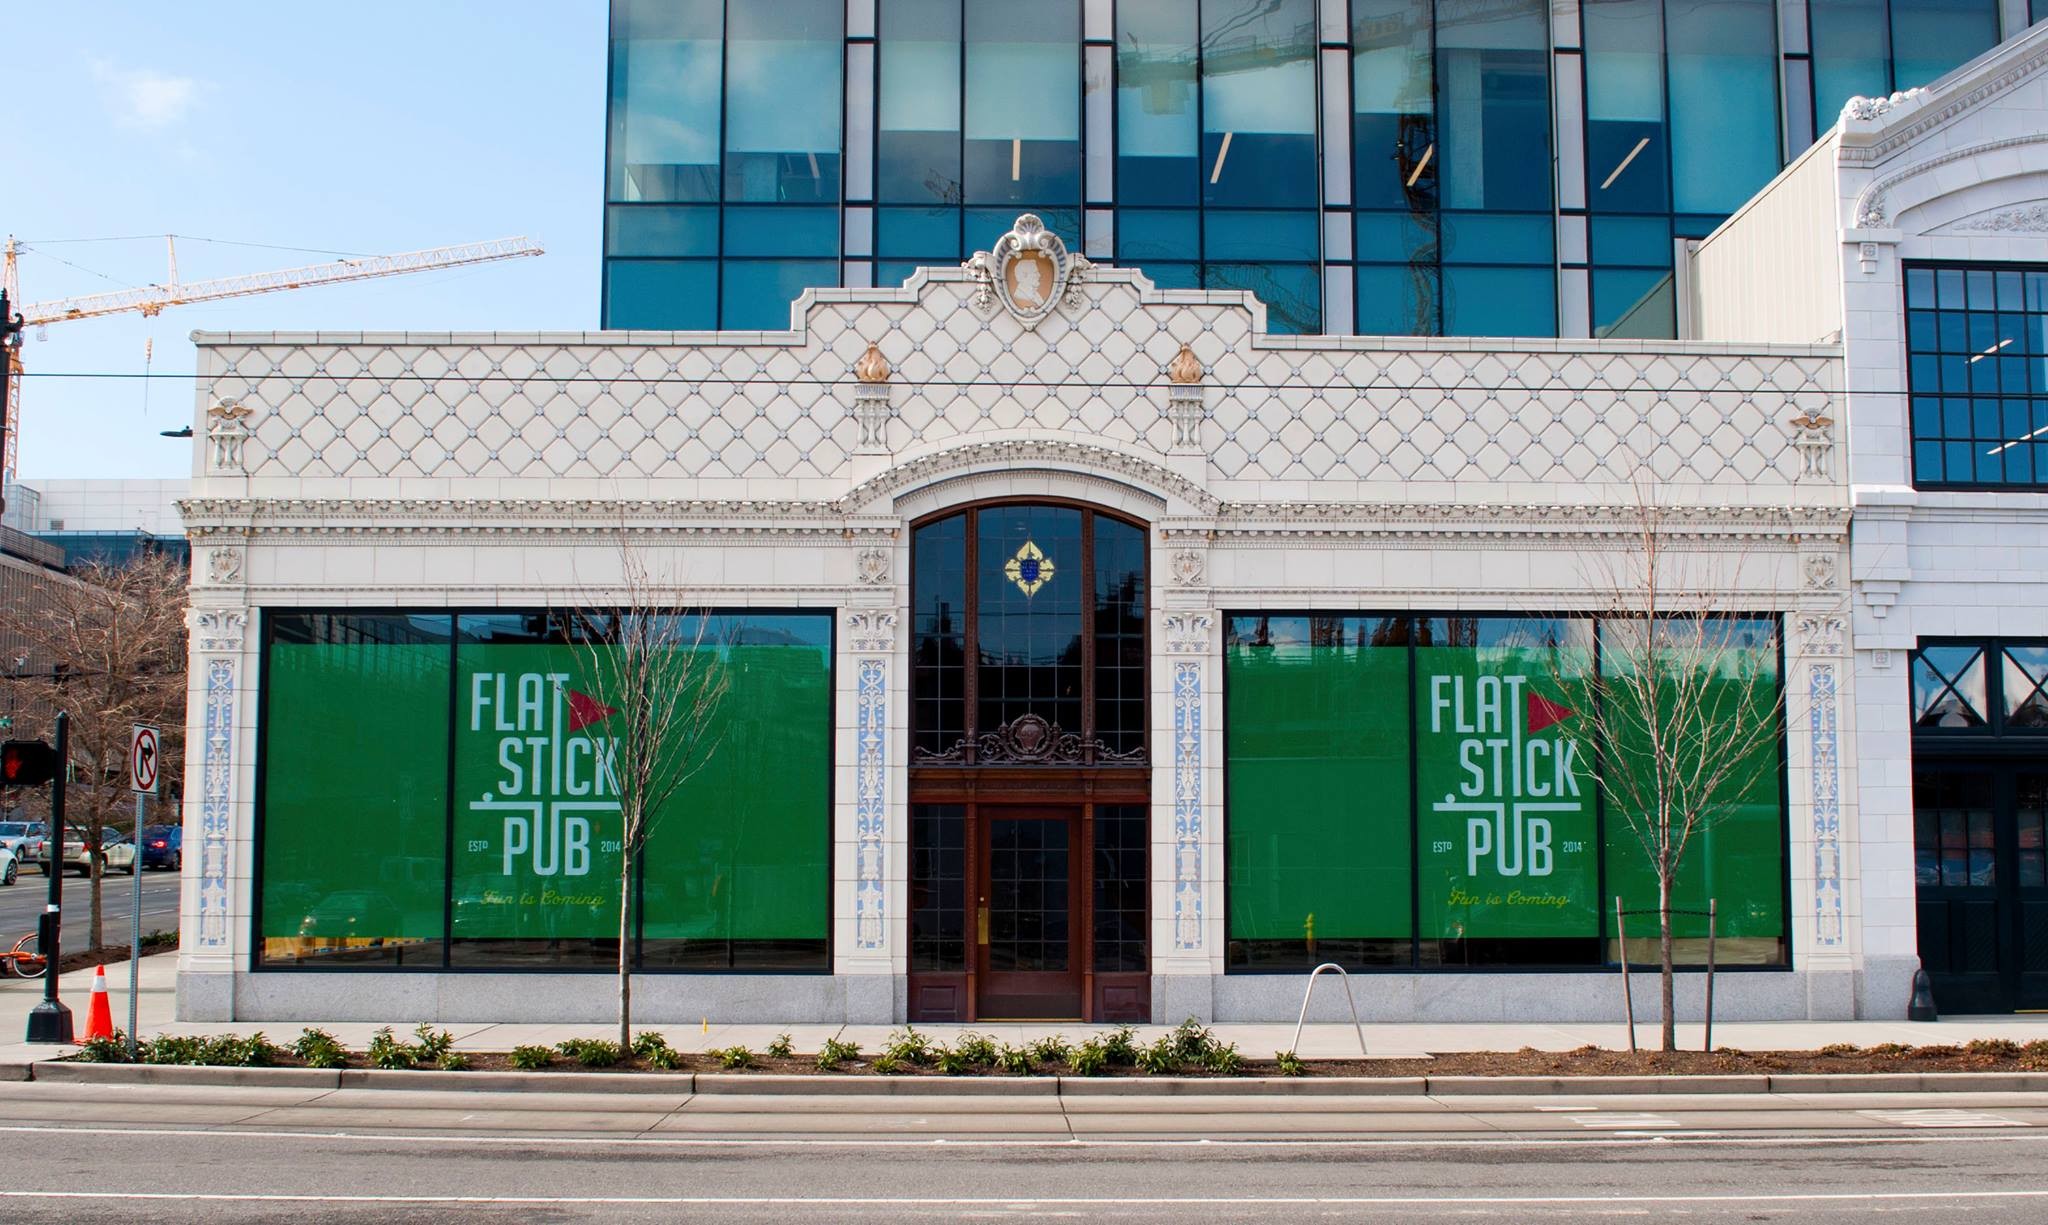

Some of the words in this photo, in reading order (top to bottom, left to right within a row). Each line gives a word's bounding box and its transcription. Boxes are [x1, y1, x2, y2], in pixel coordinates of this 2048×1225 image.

[471, 672, 570, 731] FLAT
[1430, 675, 1527, 733] FLAT
[497, 737, 622, 796] STICK
[1459, 738, 1581, 797] STICK
[503, 816, 590, 876] PUB
[600, 840, 621, 852] 2014
[1467, 817, 1553, 876] PUB
[1563, 841, 1582, 853] 2014
[480, 889, 514, 905] Fun
[519, 892, 537, 905] is
[540, 889, 605, 907] Coming
[1448, 889, 1481, 905] Fun
[1485, 892, 1502, 905] is
[1506, 889, 1567, 908] Coming
